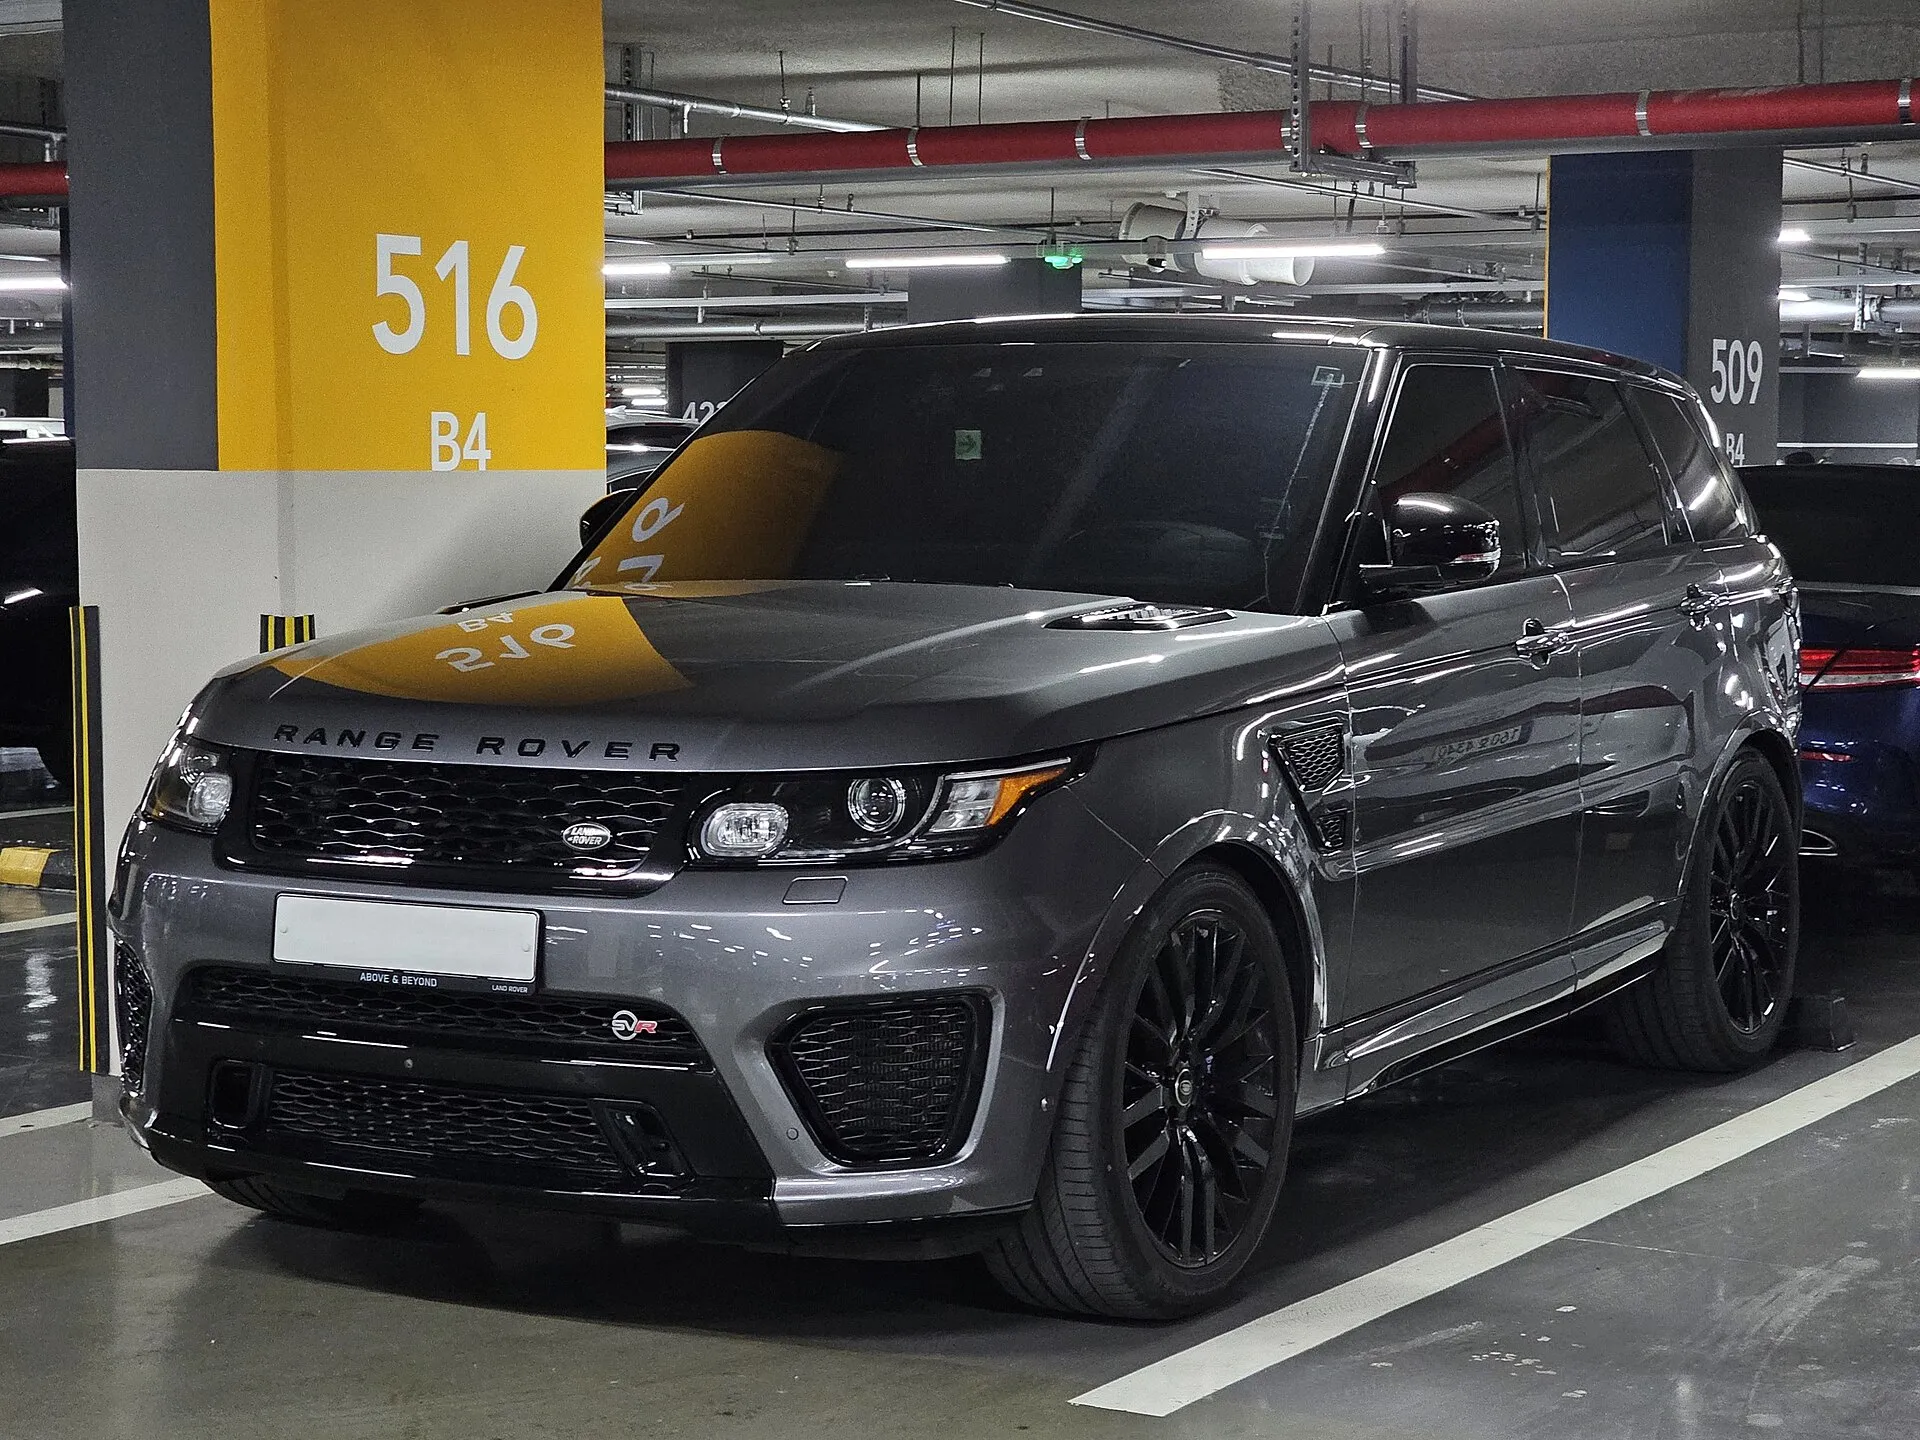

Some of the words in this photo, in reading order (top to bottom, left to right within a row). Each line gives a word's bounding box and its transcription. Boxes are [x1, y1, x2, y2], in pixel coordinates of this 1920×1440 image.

[371, 233, 539, 360] 516
[1710, 338, 1763, 405] 509
[682, 400, 727, 425] 42
[430, 411, 492, 471] B4
[1726, 432, 1745, 466] B4
[273, 724, 440, 752] RANGE
[476, 736, 681, 762] ROVER
[571, 835, 603, 845] ROVER
[360, 972, 390, 983] ABOVE
[392, 975, 399, 984] &
[401, 975, 438, 988] BEYOND
[508, 985, 528, 994] ROVER
[611, 1012, 658, 1038] SVR
